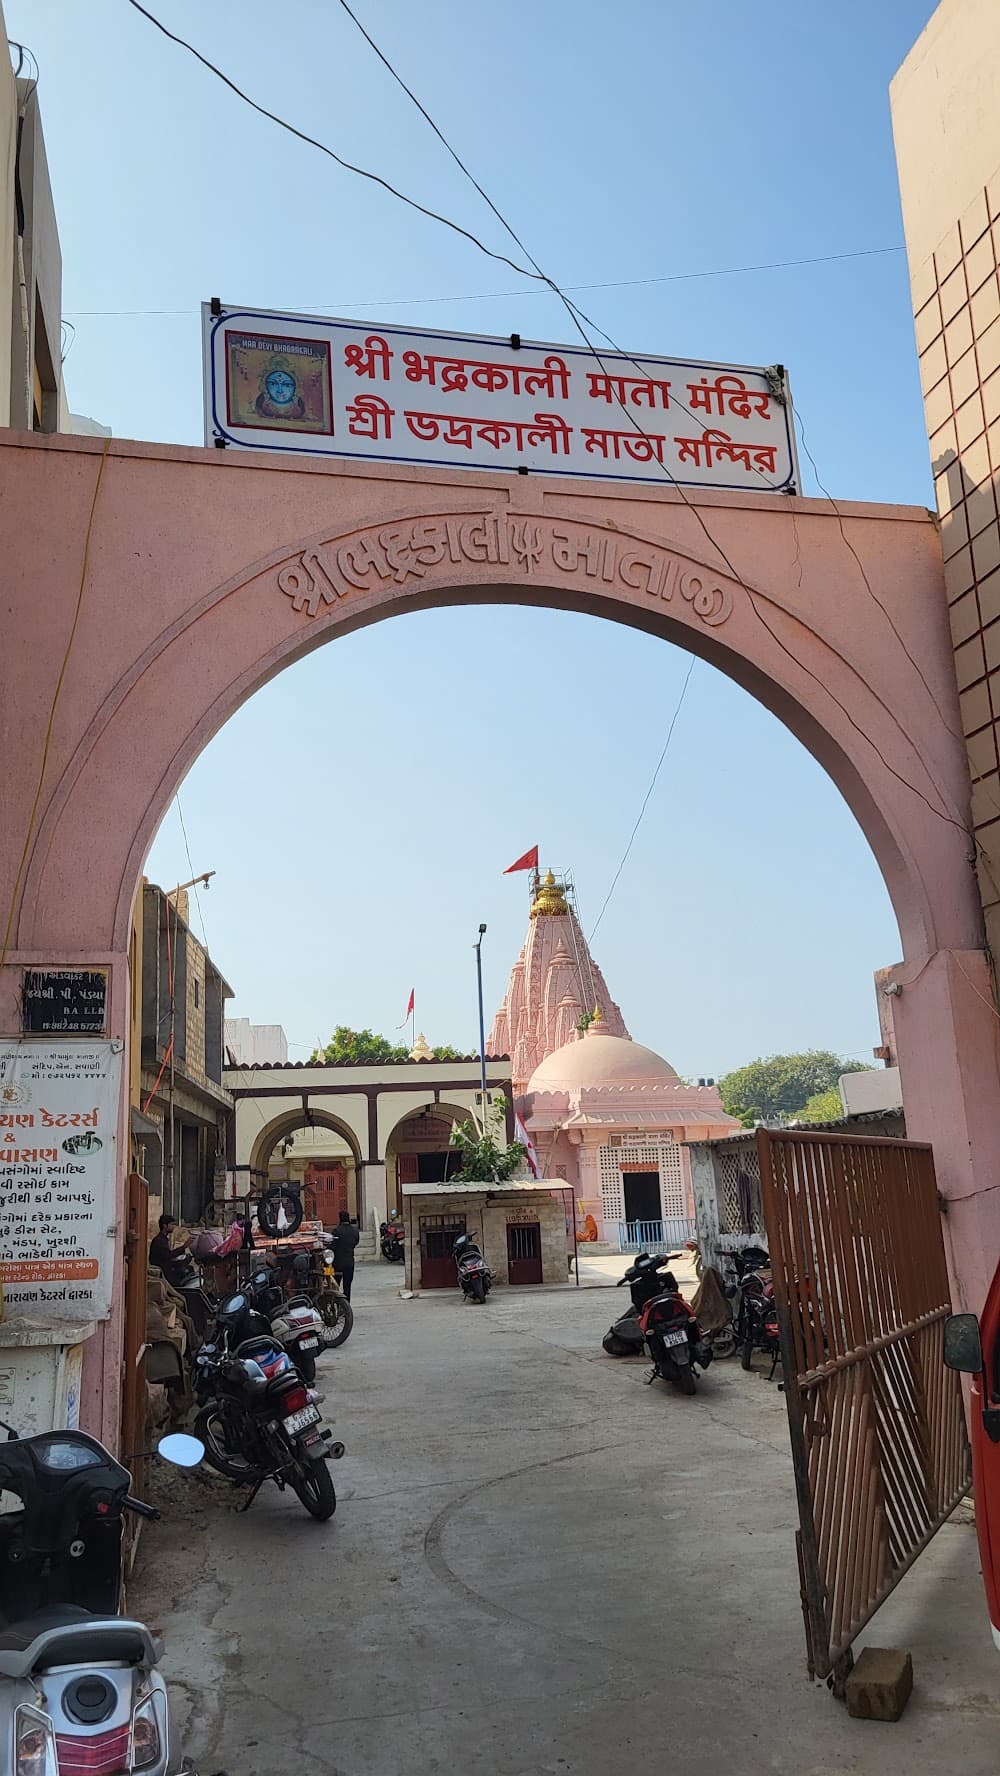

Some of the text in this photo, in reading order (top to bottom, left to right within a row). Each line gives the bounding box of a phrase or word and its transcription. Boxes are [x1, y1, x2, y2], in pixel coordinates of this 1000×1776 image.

[258, 342, 272, 351] DEVI
[344, 335, 772, 421] श्री भद्रकाली माता मंदिर
[344, 394, 395, 440] শ্রী
[581, 427, 666, 463] মাতা
[674, 428, 778, 475] মন্দির
[277, 545, 348, 617] શ્રી
[551, 528, 734, 627] માતાજી
[39, 1108, 100, 1128] કેટરર્સ
[4, 1132, 16, 1142] &
[47, 1163, 86, 1175] સ્વાદિષ્ટ
[50, 1180, 70, 1189] કામ
[35, 1191, 52, 1203] કરી
[15, 1225, 36, 1235] ડીસ
[18, 1249, 53, 1260] ભાડેથી
[39, 1287, 66, 1302] કેટરર્સ
[68, 1289, 93, 1301] દ્વારકા
